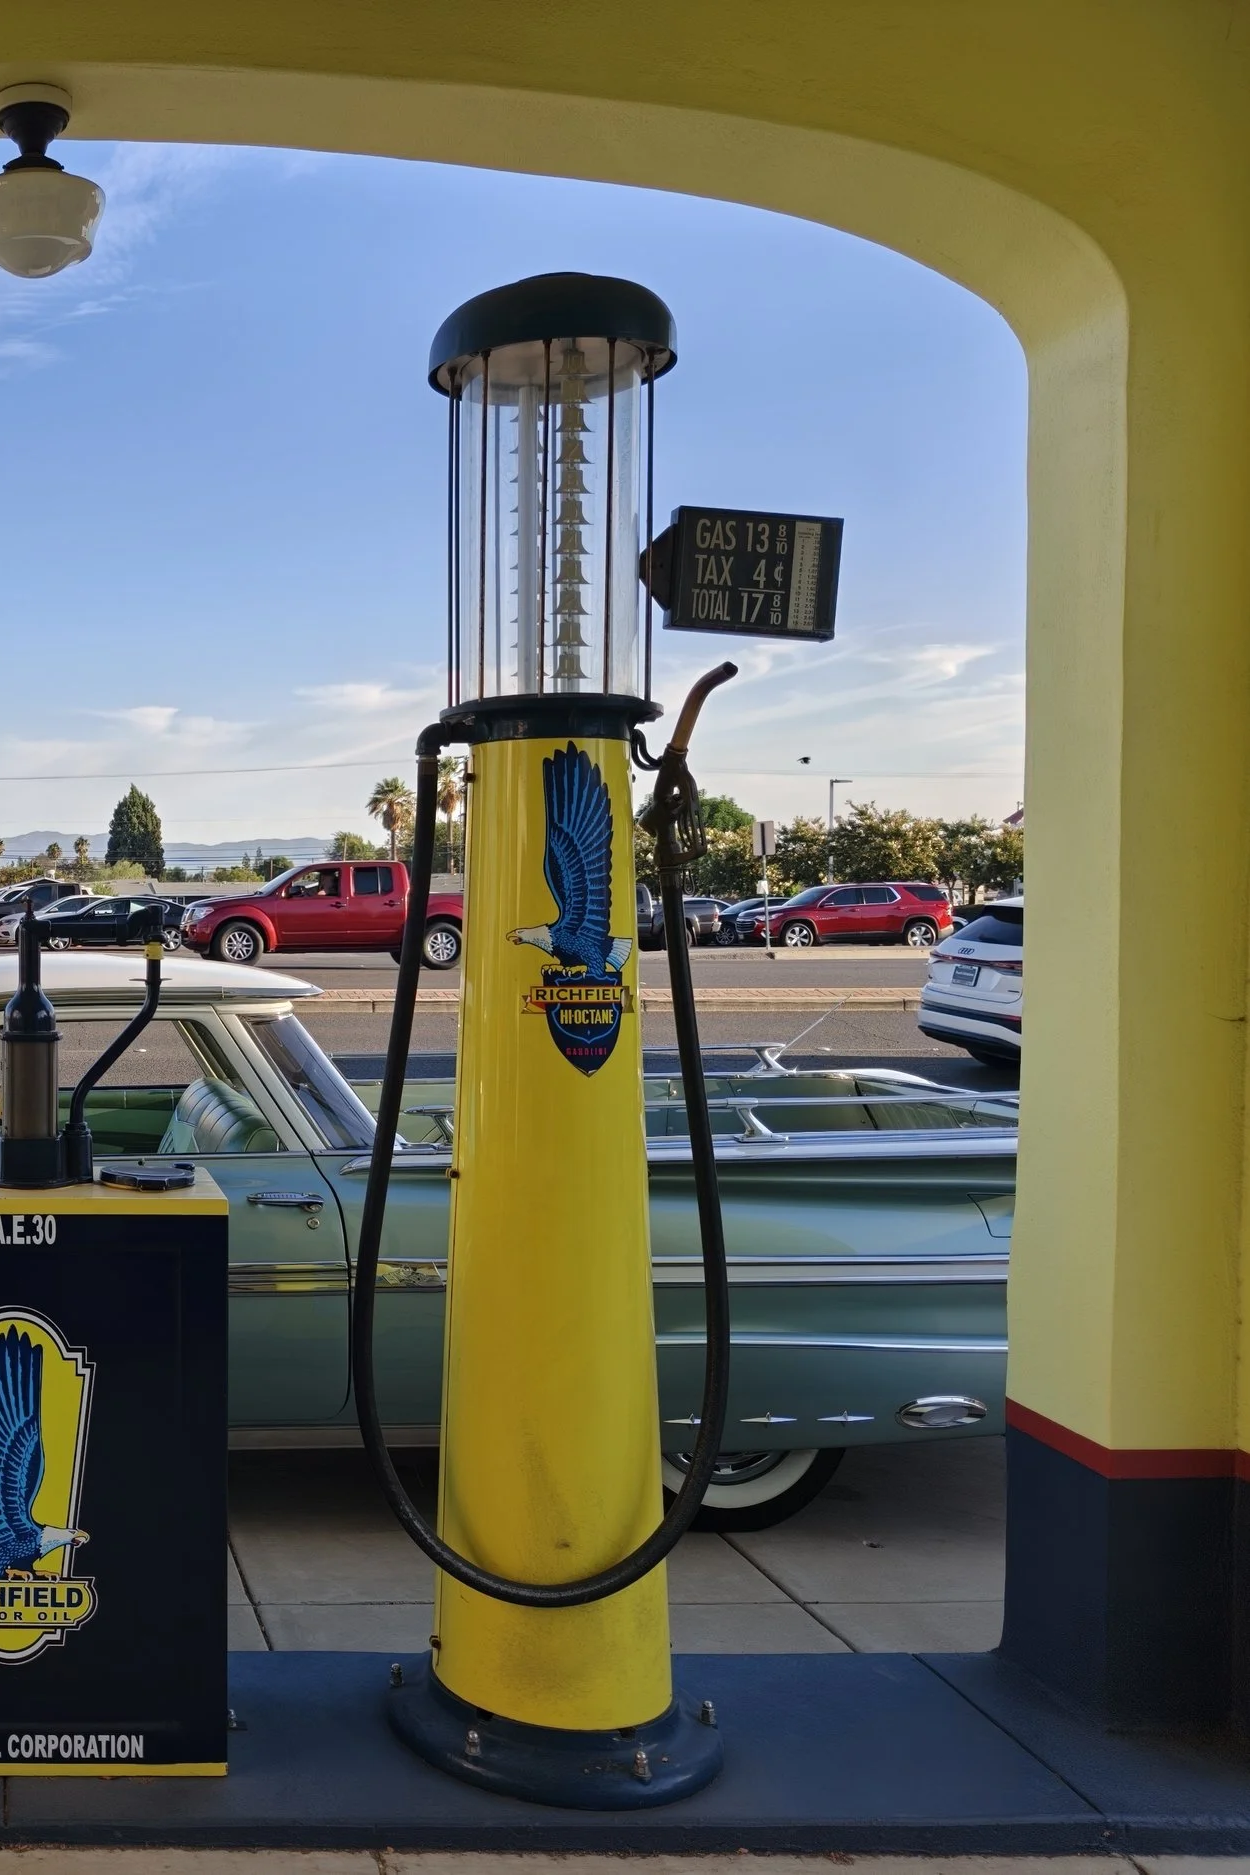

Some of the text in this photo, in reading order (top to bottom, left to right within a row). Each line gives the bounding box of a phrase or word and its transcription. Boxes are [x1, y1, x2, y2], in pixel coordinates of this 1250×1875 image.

[695, 518, 737, 551] GAS
[746, 521, 770, 554] 13
[695, 554, 784, 589] TAX 4 ¢
[691, 588, 731, 621] TOTAL
[741, 592, 765, 623] 17
[535, 988, 623, 1001] RICHFIEL
[37, 1611, 71, 1621] OIL
[7, 1734, 144, 1759] CORPORATION
